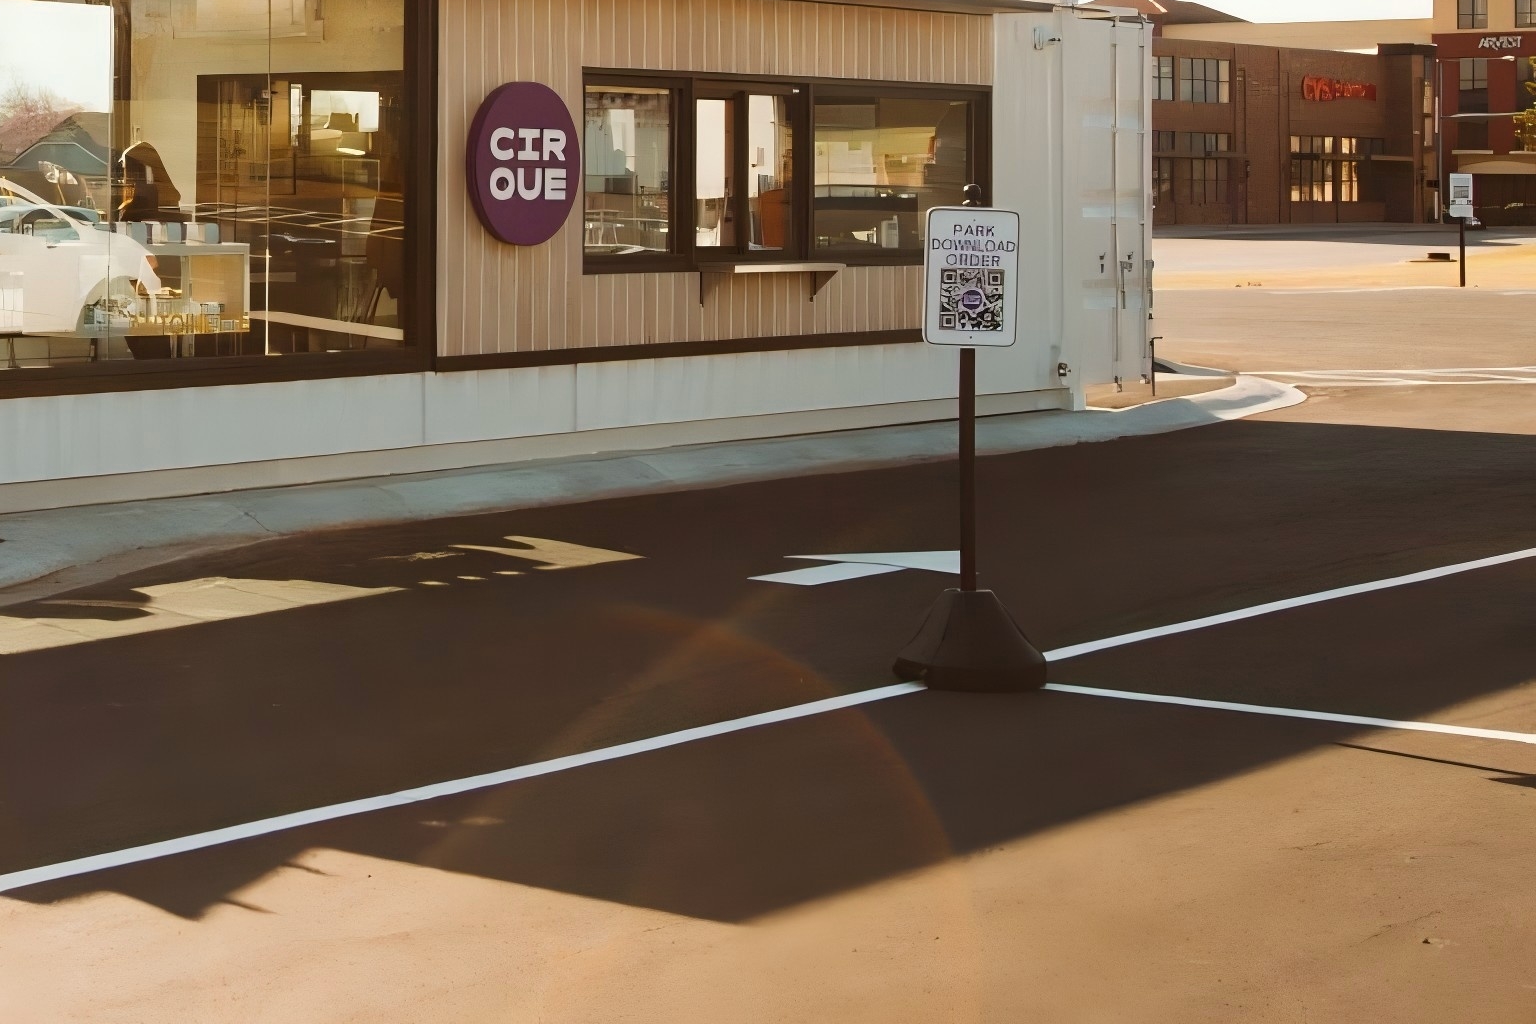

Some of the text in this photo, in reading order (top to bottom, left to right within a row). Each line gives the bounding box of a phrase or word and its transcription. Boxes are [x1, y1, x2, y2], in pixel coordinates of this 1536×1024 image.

[490, 127, 567, 161] CIR
[953, 224, 995, 237] PARK
[931, 238, 1016, 253] DOWNLOAD
